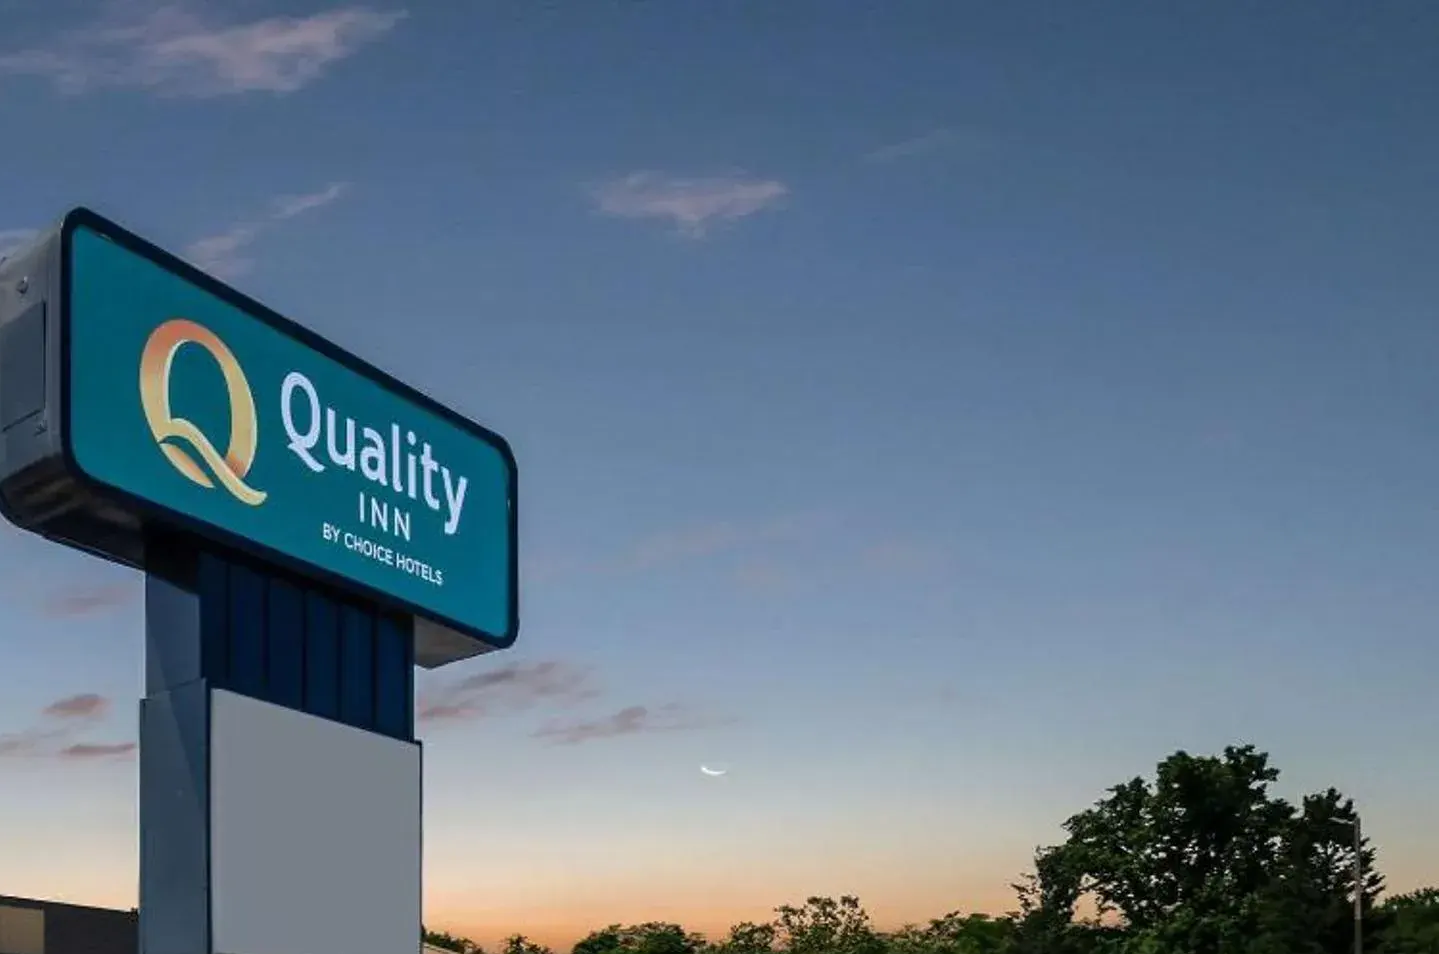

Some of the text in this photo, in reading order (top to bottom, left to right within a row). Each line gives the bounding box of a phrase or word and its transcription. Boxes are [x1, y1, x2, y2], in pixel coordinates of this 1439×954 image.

[139, 317, 268, 506] Q
[280, 371, 469, 535] Quality
[323, 521, 444, 586] BY CHOICE HOTELS
[359, 491, 411, 542] INN
